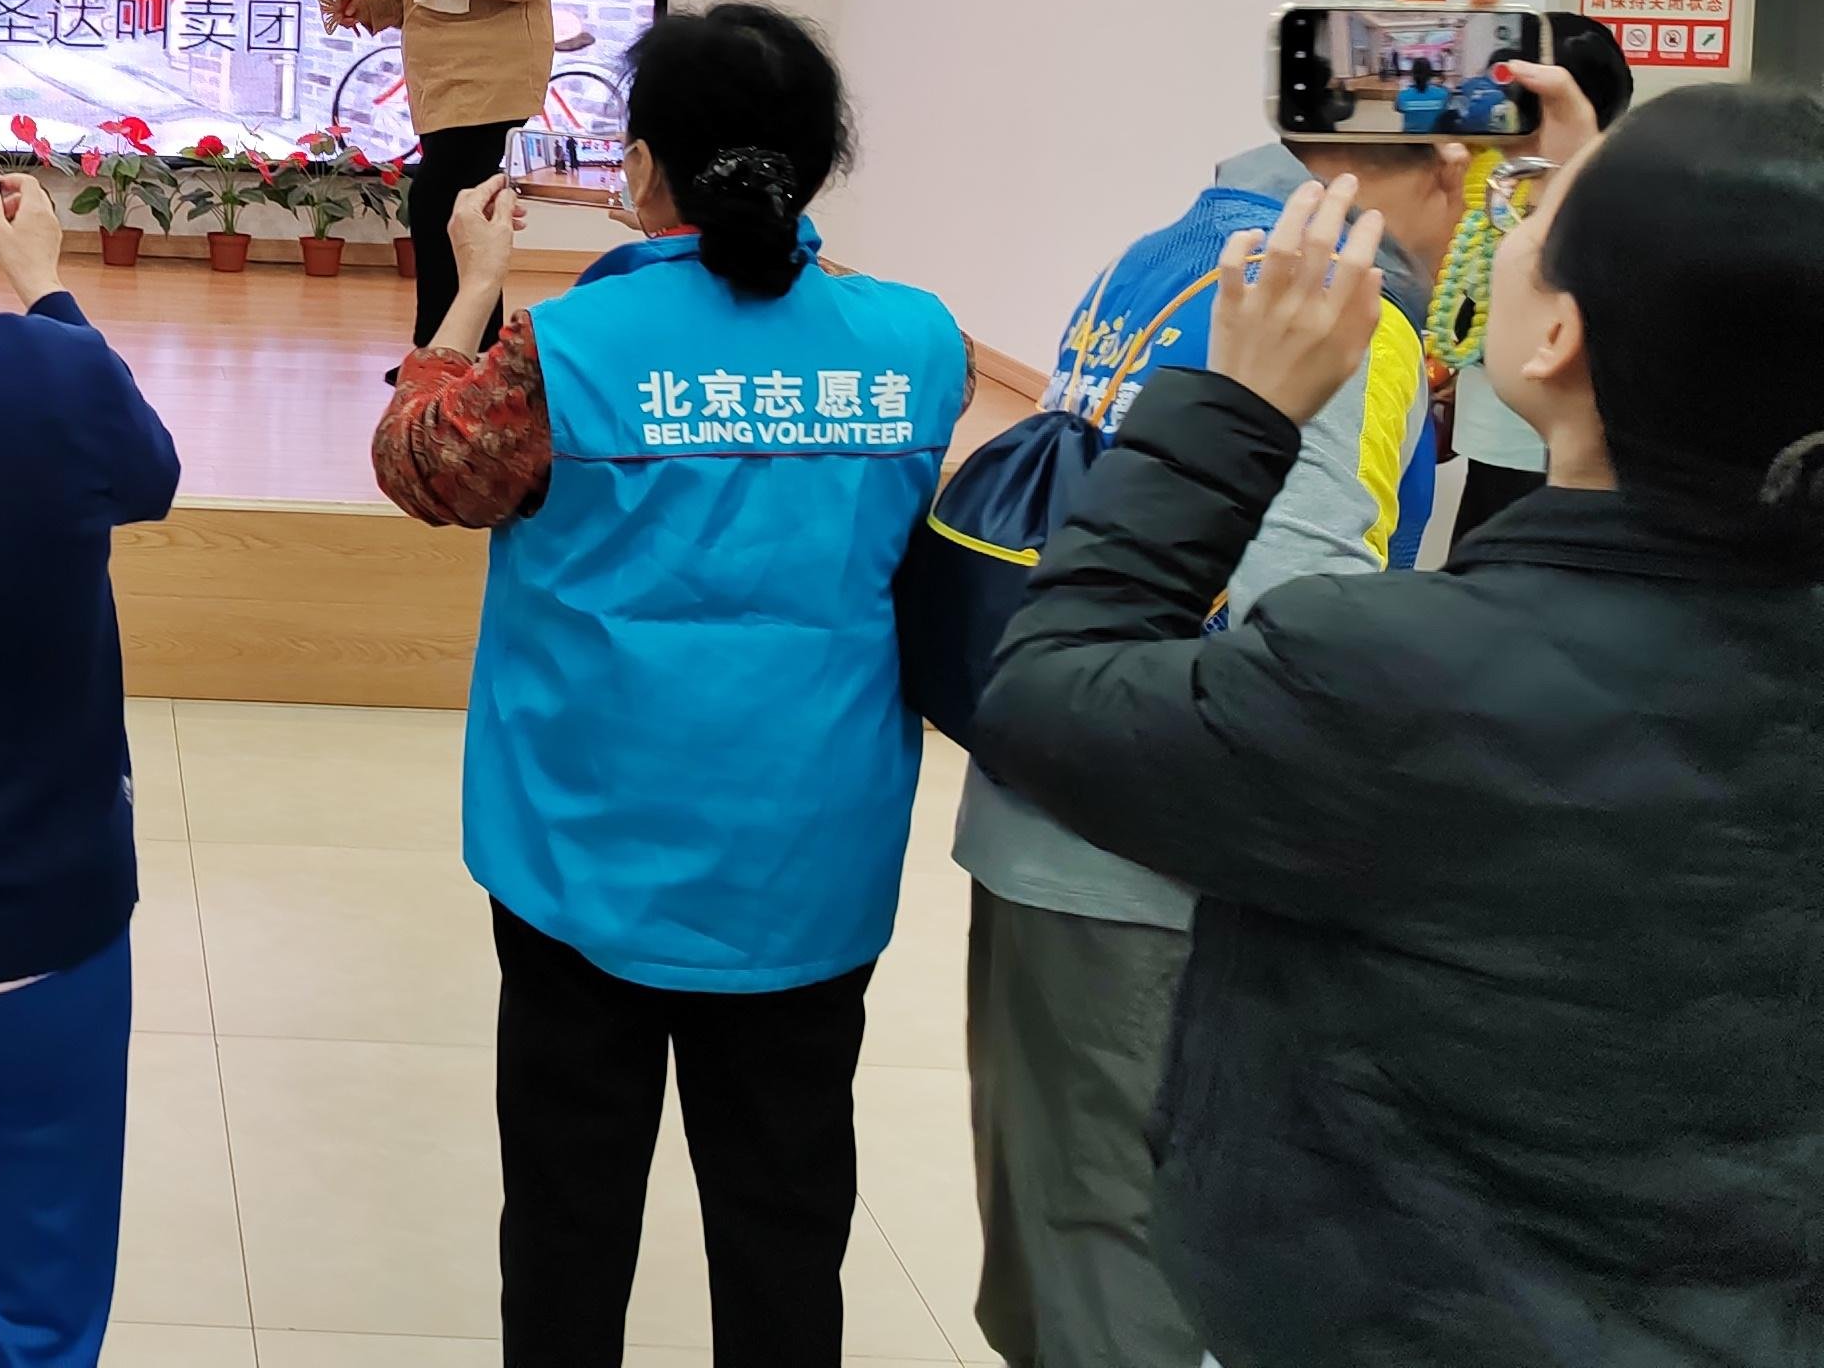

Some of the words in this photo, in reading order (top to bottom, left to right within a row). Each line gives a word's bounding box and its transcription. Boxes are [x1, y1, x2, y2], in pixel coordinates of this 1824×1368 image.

[637, 368, 913, 419] 北京志愿者
[642, 421, 755, 446] BEIJING
[756, 420, 914, 446] VOLUNTEER
